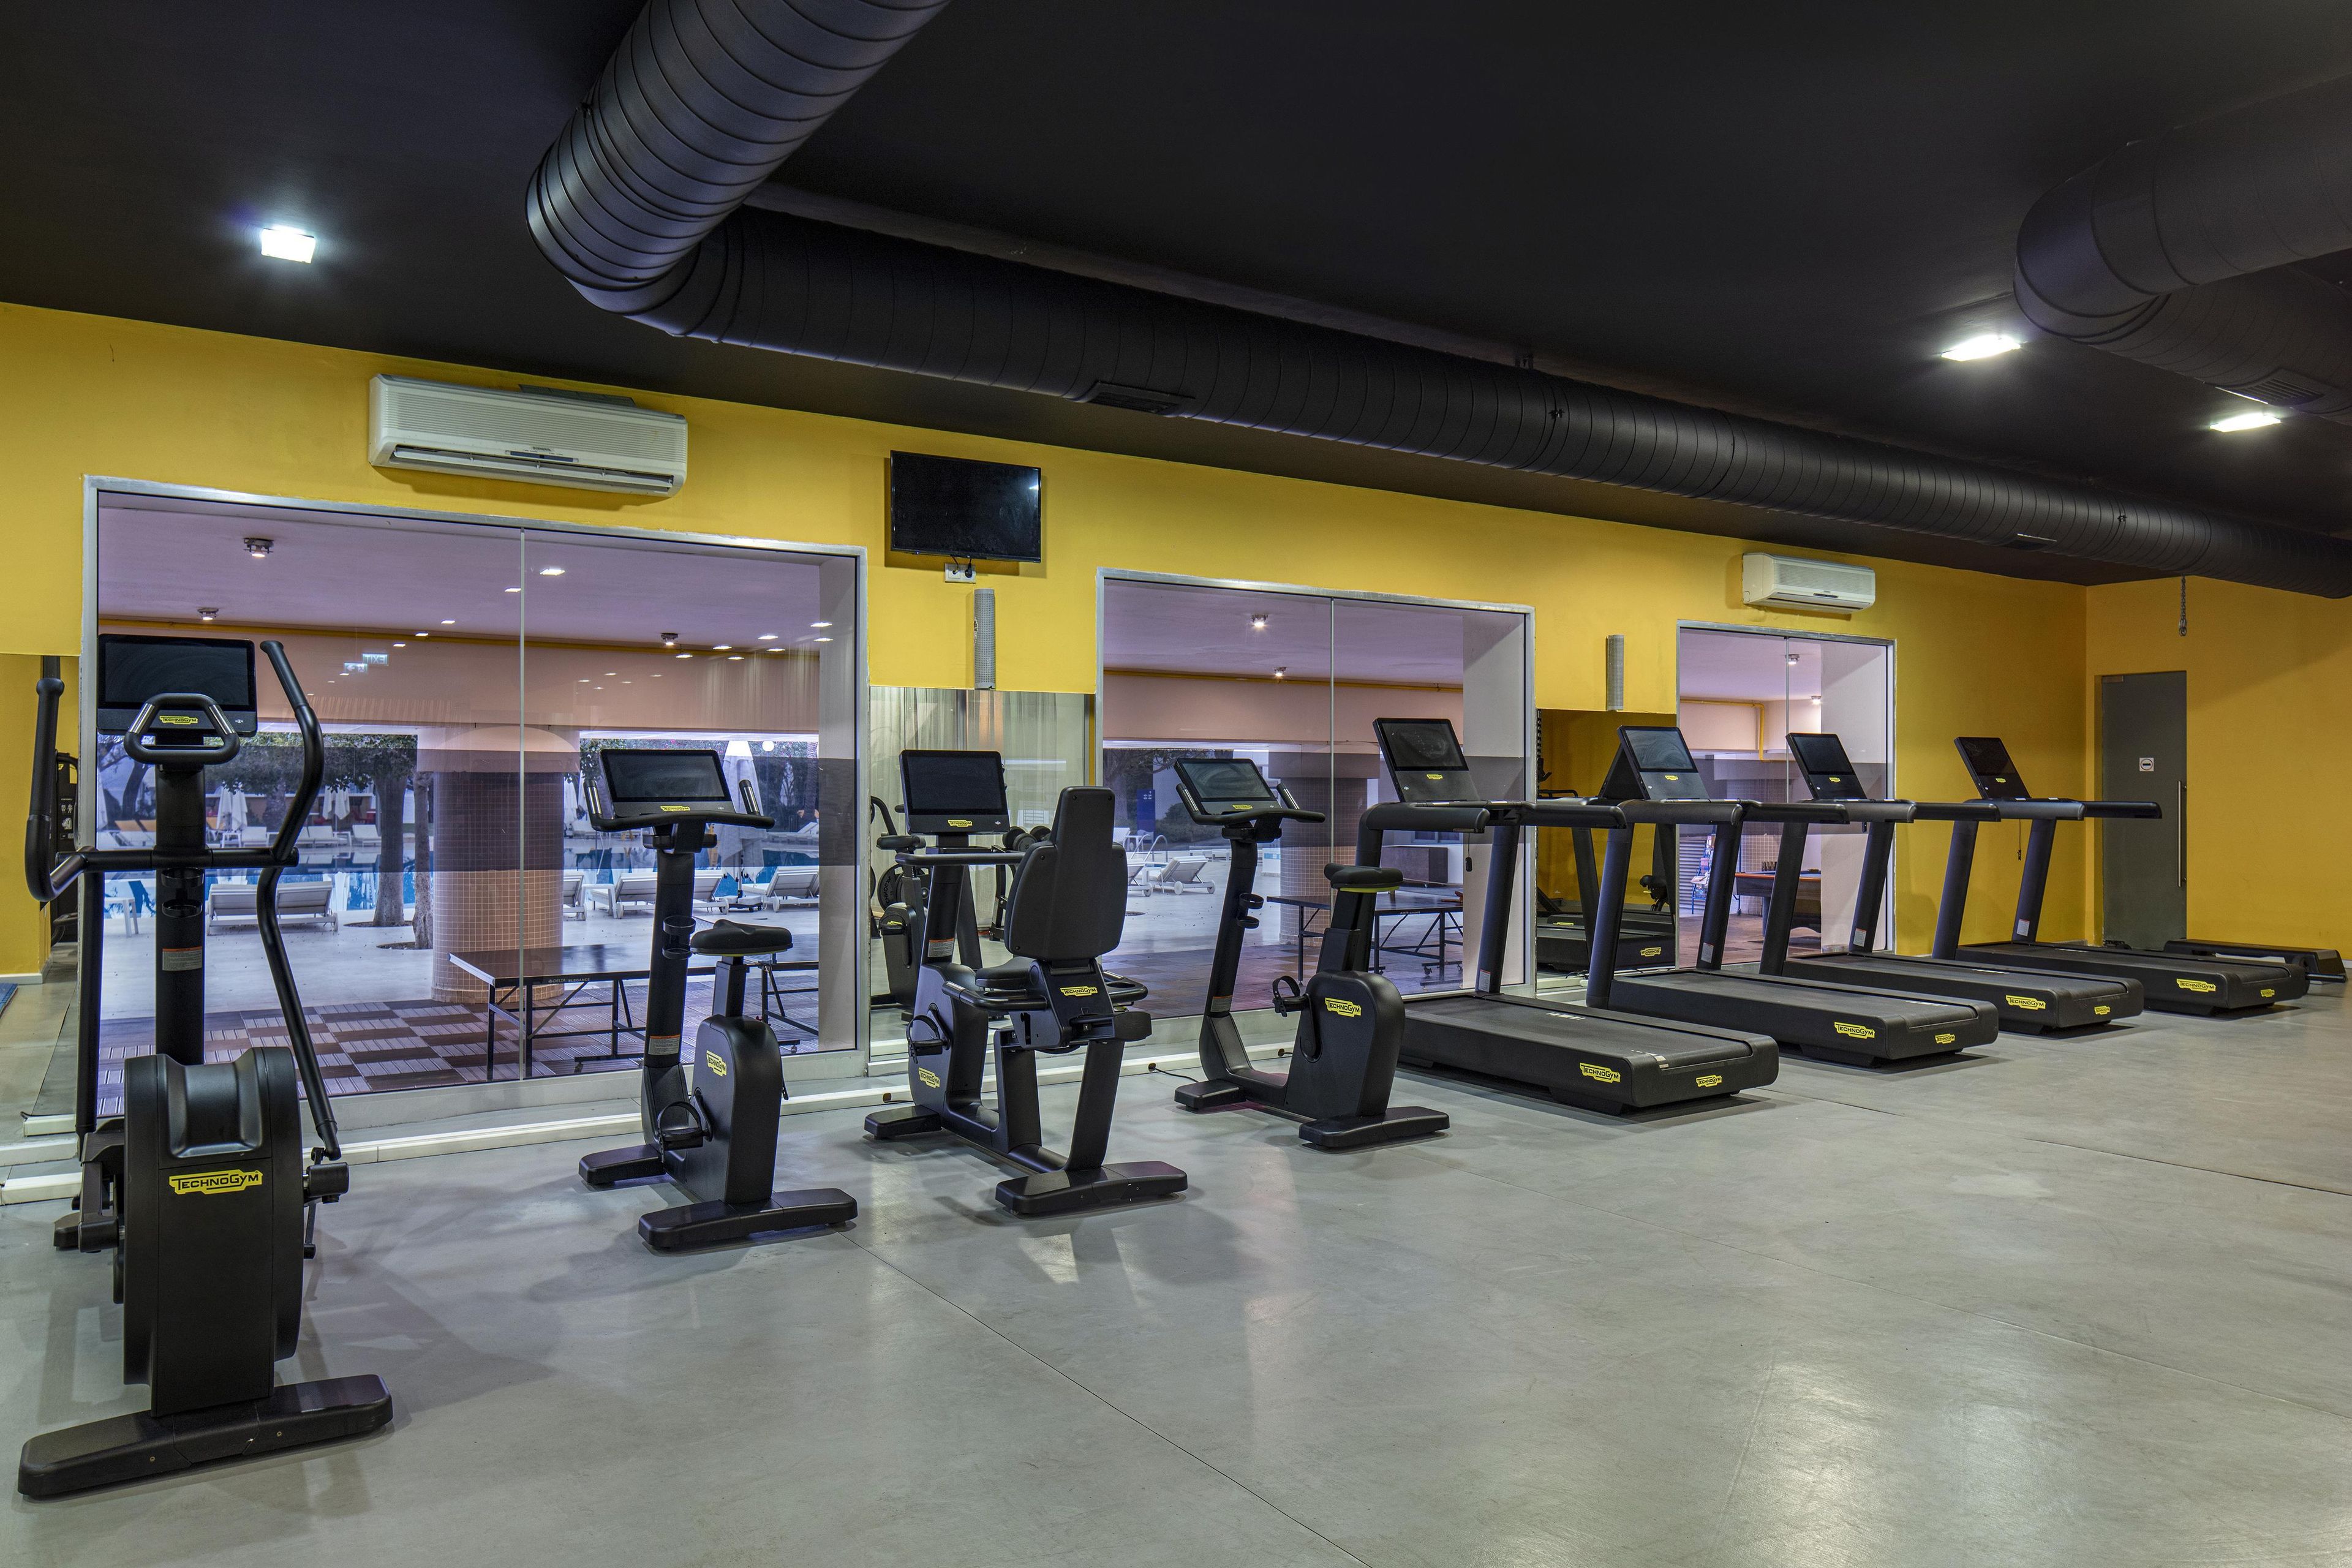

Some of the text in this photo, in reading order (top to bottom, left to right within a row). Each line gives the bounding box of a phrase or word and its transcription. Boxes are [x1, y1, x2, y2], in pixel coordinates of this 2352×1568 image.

[1061, 987, 1096, 995] TECHNOGYM
[2178, 980, 2215, 990] TECHNOGYM
[1325, 999, 1360, 1014] TECHNOGYM
[2007, 997, 2044, 1008] TECHNOGYM
[1836, 1023, 1874, 1036] TECHNOGYM
[707, 1053, 726, 1072] TECHNOGYM
[919, 1069, 939, 1085] TECHNOGYM
[1581, 1065, 1619, 1080] TECHNOGYM
[172, 1173, 259, 1191] TECHNOGYM
